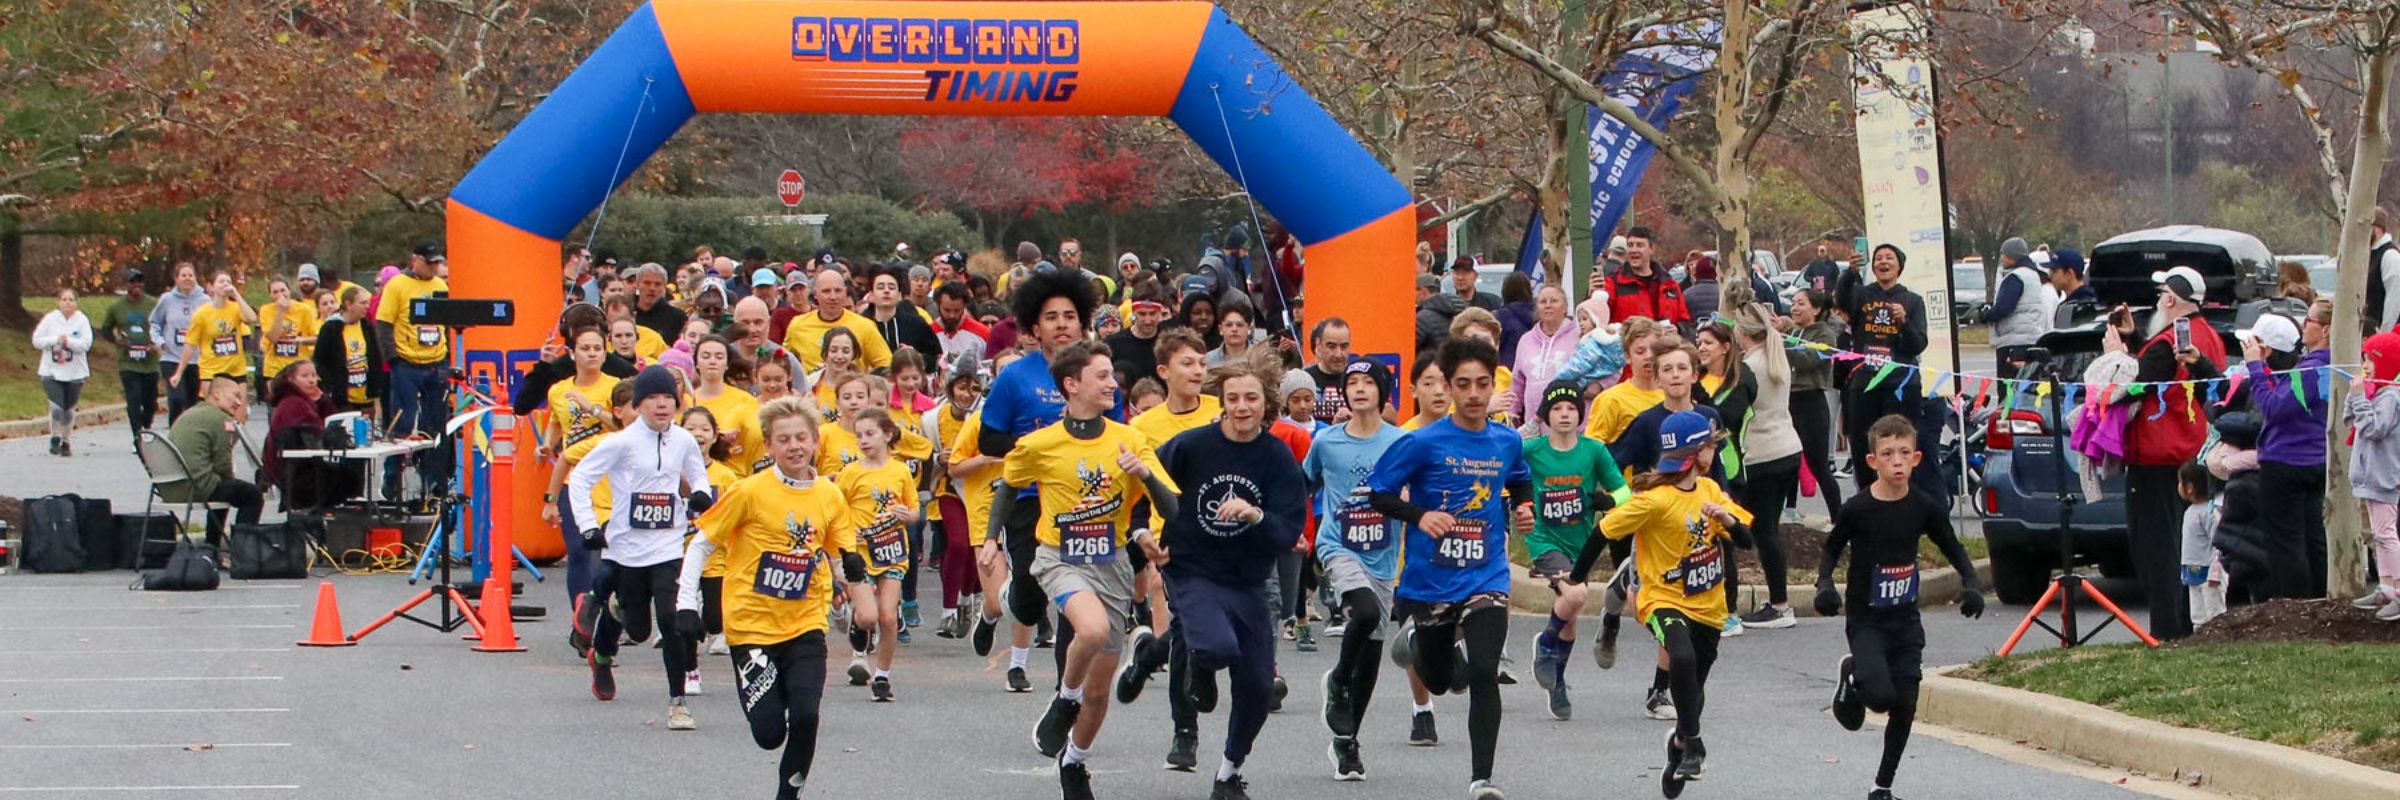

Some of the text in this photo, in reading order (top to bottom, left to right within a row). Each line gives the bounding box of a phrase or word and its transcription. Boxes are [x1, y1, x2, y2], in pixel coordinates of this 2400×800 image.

[795, 21, 1076, 58] OVERLAND
[924, 70, 1079, 102] TIMING
[780, 181, 802, 195] STOP
[1461, 456, 1504, 469] Augustine
[633, 505, 672, 522] 4289
[1543, 498, 1582, 519] 4365
[1347, 523, 1384, 543] 4816
[874, 541, 903, 562] 3719
[1065, 536, 1109, 556] 1266
[1440, 538, 1484, 560] 4315
[763, 567, 806, 591] 1024
[1687, 556, 1722, 588] 4364
[1879, 576, 1912, 598] 1187
[746, 661, 776, 697] UNDER
[746, 668, 779, 713] ARMOUR
